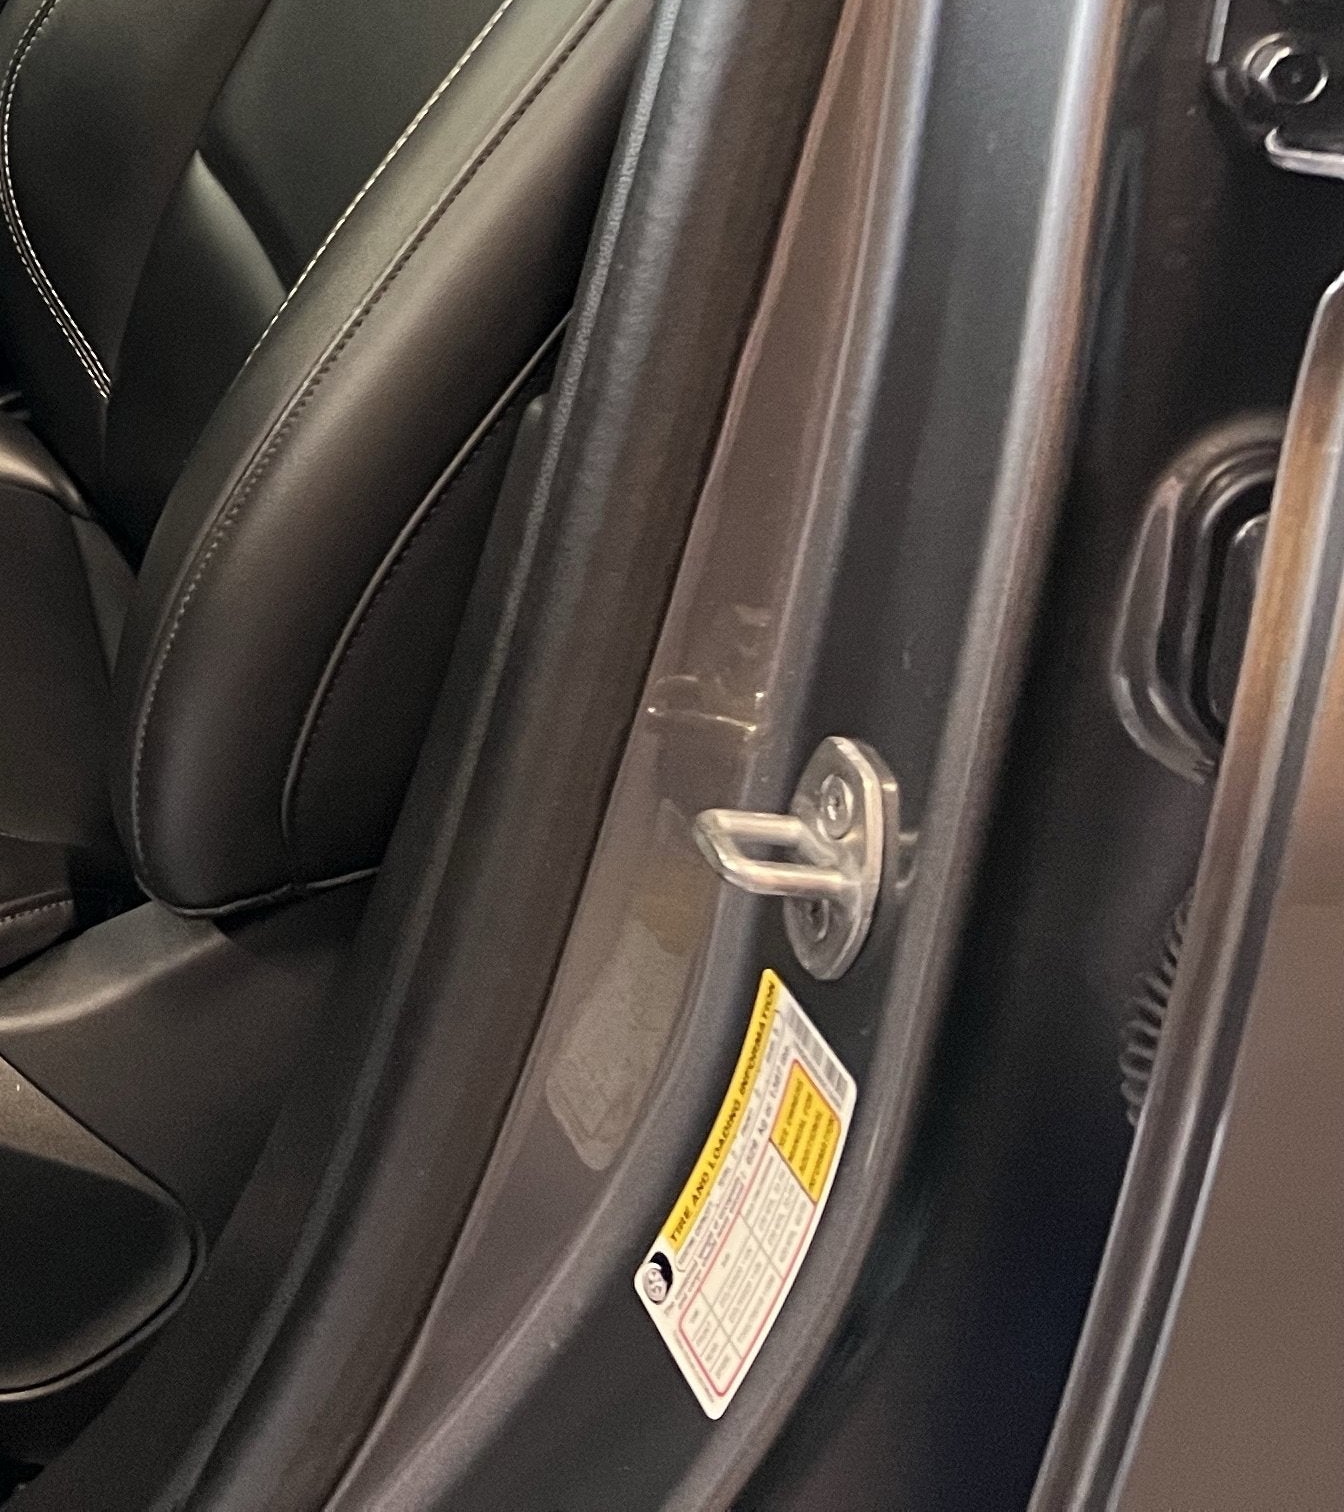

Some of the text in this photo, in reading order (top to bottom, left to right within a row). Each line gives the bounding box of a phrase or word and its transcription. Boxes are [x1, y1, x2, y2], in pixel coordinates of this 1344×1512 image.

[670, 1208, 694, 1243] TIRE
[691, 1172, 710, 1207] AND
[708, 1099, 742, 1171] LOADING
